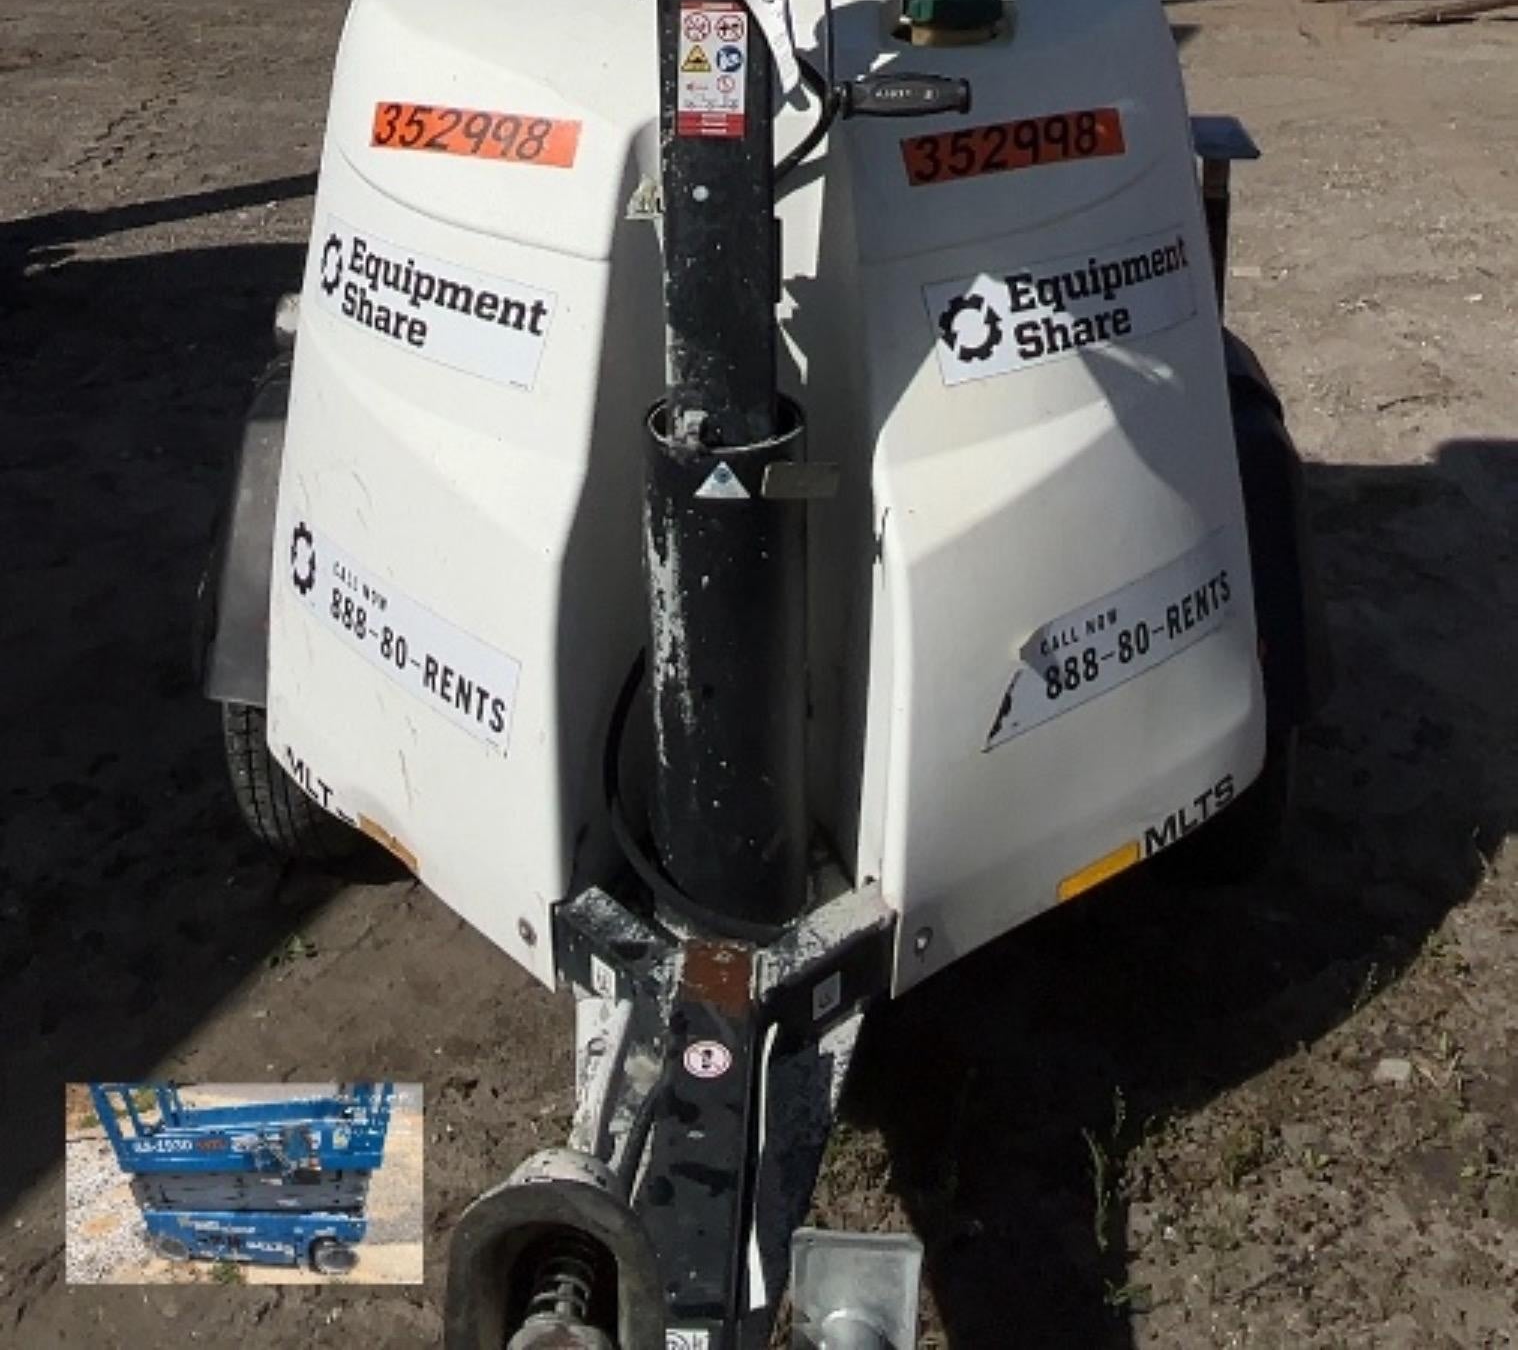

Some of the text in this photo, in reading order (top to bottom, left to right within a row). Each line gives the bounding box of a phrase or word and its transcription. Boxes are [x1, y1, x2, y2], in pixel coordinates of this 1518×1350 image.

[374, 103, 551, 161] 352998
[914, 110, 1098, 182] 352998
[347, 236, 548, 336] Equipment
[1005, 237, 1189, 313] Equipment
[341, 284, 428, 347] Share
[1013, 307, 1132, 361] Share
[329, 588, 507, 735] 888-80-RENTS
[1040, 607, 1118, 656] CALL NOW
[1045, 569, 1232, 700] 888-80-RENTS
[1143, 773, 1236, 857] MLTS
